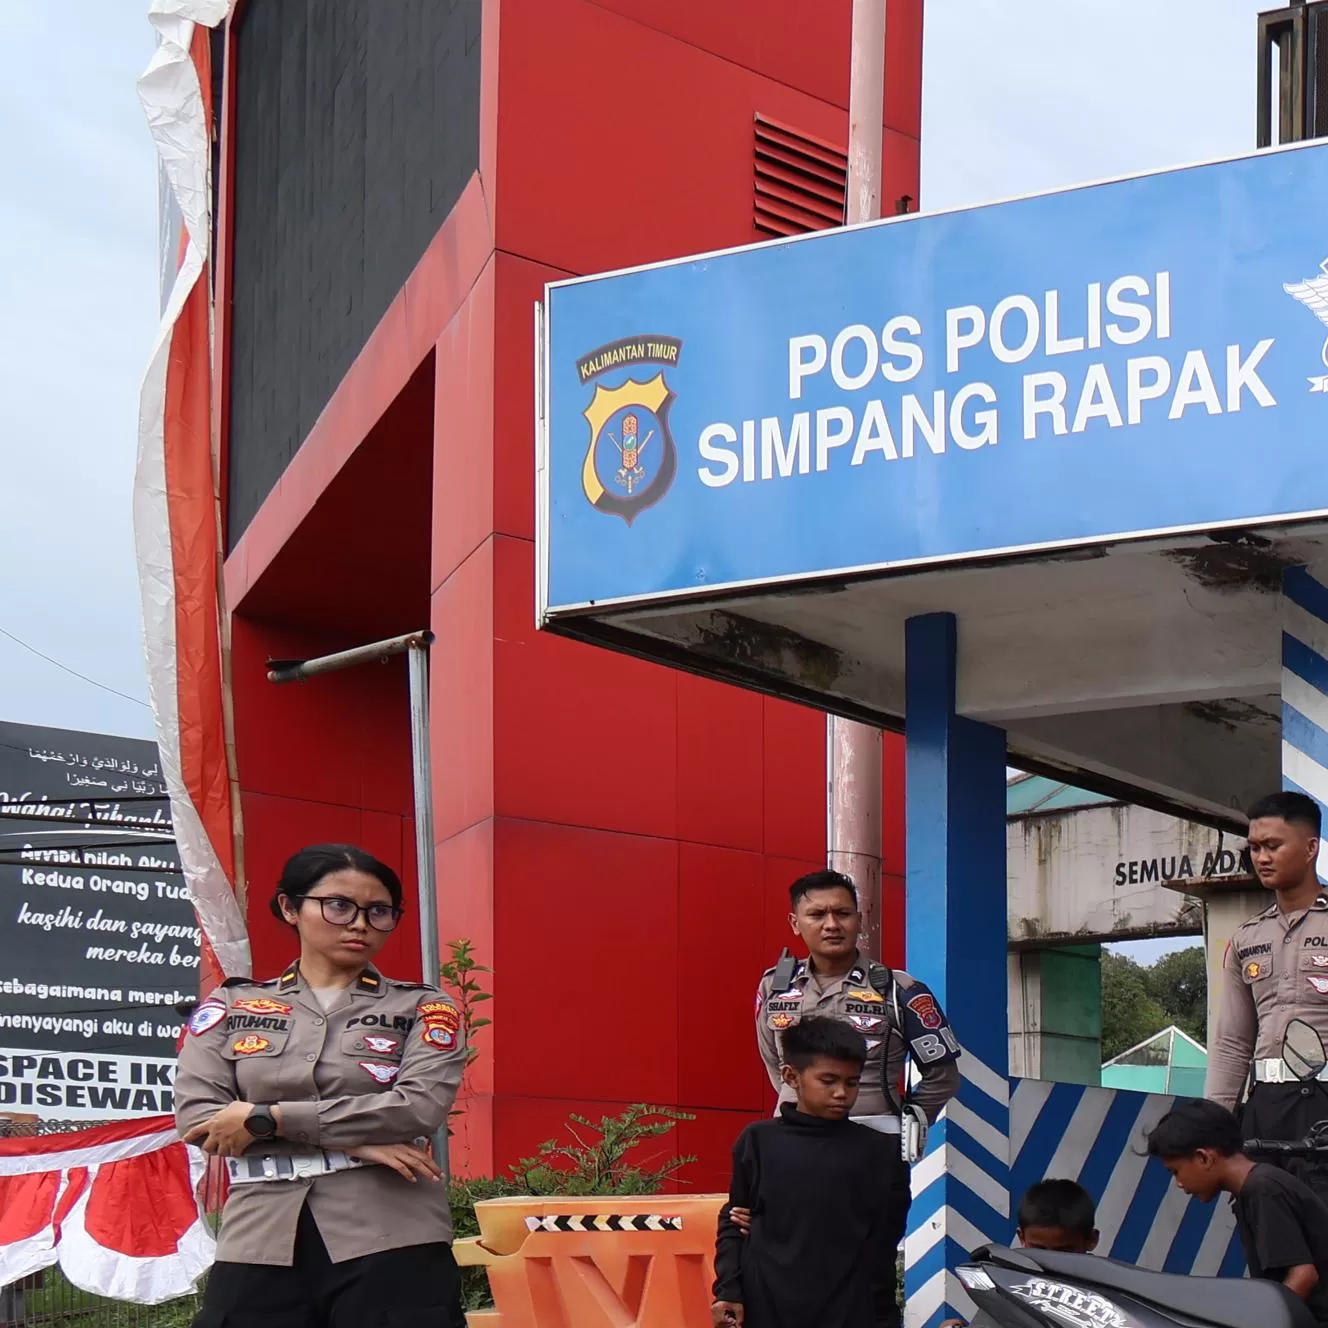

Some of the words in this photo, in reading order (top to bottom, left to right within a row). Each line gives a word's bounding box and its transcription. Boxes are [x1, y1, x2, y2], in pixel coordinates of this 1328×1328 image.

[789, 313, 925, 399] POS
[946, 271, 1171, 373] POLISI
[581, 344, 644, 378] KALIMANTAN
[647, 343, 677, 360] TIMUR
[697, 394, 998, 488] SIMPANG
[1022, 337, 1278, 441] RAPAK
[22, 868, 84, 889] Kedua
[90, 875, 149, 900] Orang
[155, 881, 190, 900] Tua
[1115, 855, 1194, 886] SEMUA
[17, 902, 83, 931] kasihi
[86, 909, 128, 933] dan
[86, 942, 166, 966] mereka
[0, 978, 122, 1001] ebagaimana
[769, 1002, 800, 1012] SHAFLY
[103, 1018, 133, 1036] aku
[138, 1021, 152, 1037] di
[157, 1023, 187, 1039] wa
[346, 1013, 414, 1031] POLRI
[131, 1062, 178, 1086] IK
